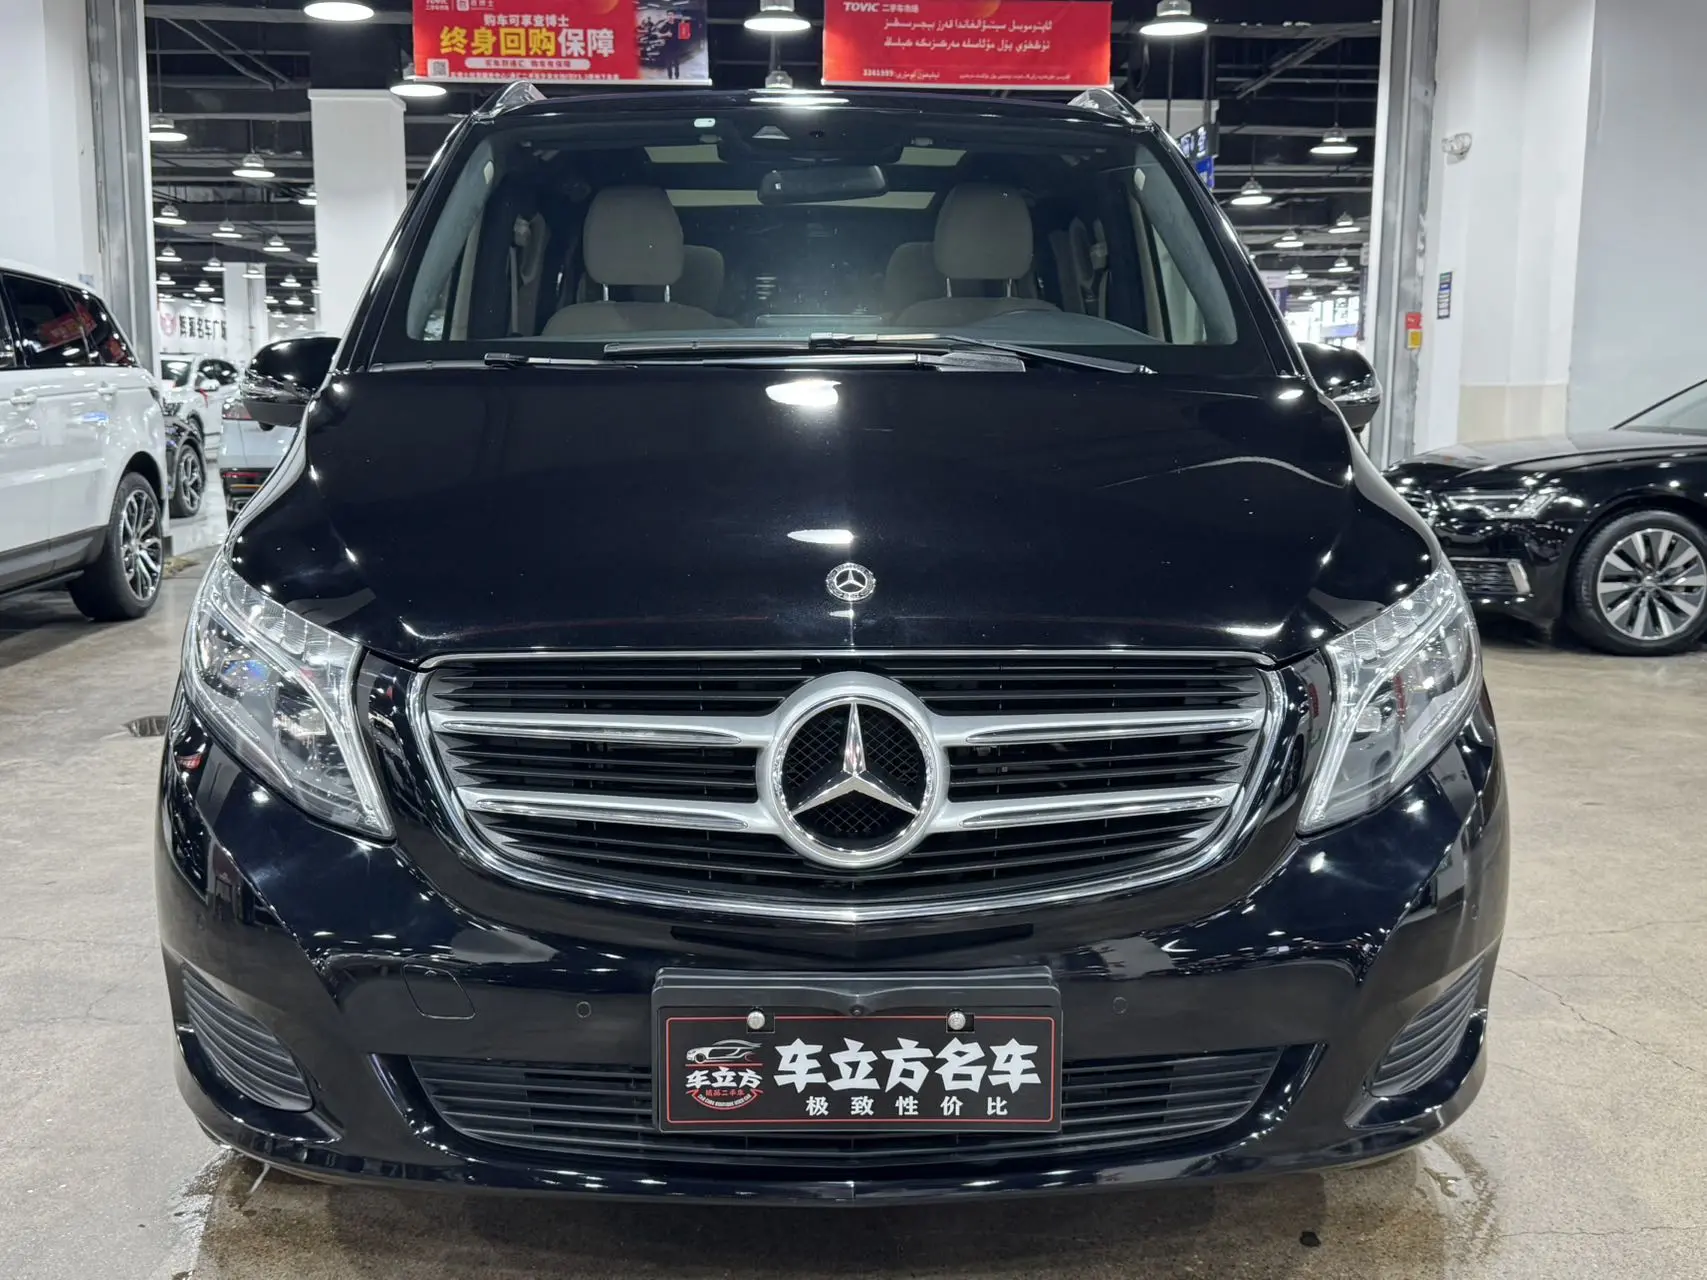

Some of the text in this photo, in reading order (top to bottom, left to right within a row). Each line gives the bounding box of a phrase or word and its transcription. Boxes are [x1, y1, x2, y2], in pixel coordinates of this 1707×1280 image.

[842, 2, 880, 12] TOVIC
[483, 13, 570, 28] 购车可享查博士
[439, 26, 615, 57] 终身回购保障
[773, 1037, 1042, 1094] 车立方名车
[685, 1066, 763, 1089] 车立方
[806, 1095, 1009, 1116] 极致性价比
